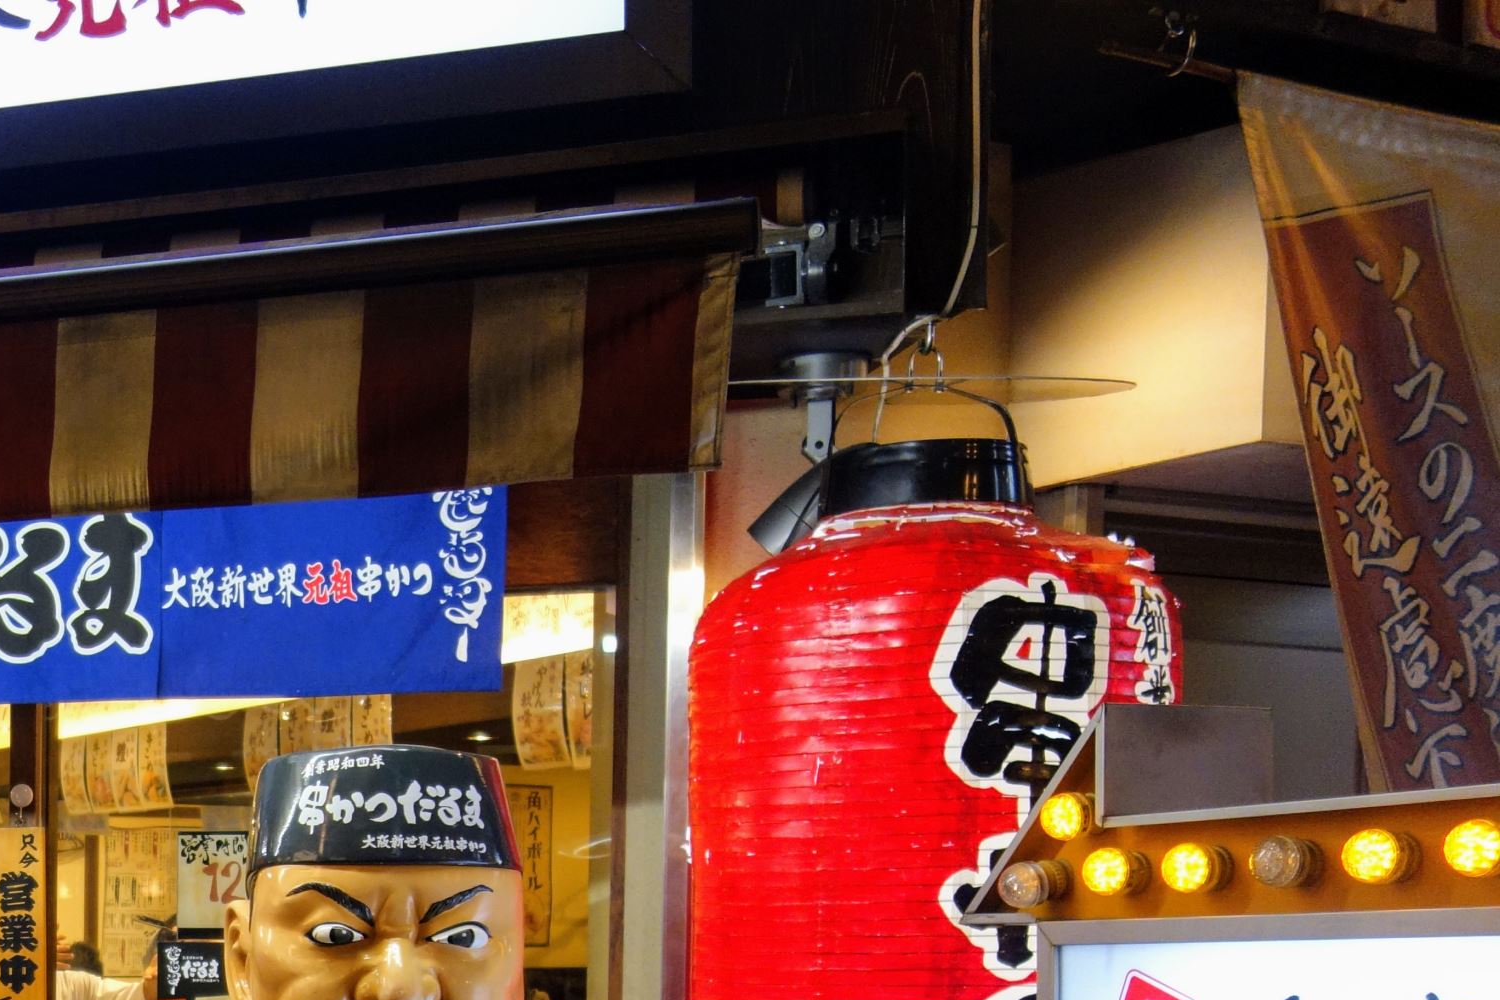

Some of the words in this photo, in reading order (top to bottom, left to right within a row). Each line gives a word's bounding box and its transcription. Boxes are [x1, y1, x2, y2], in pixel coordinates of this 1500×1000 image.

[298, 780, 485, 835] 串かつだるま
